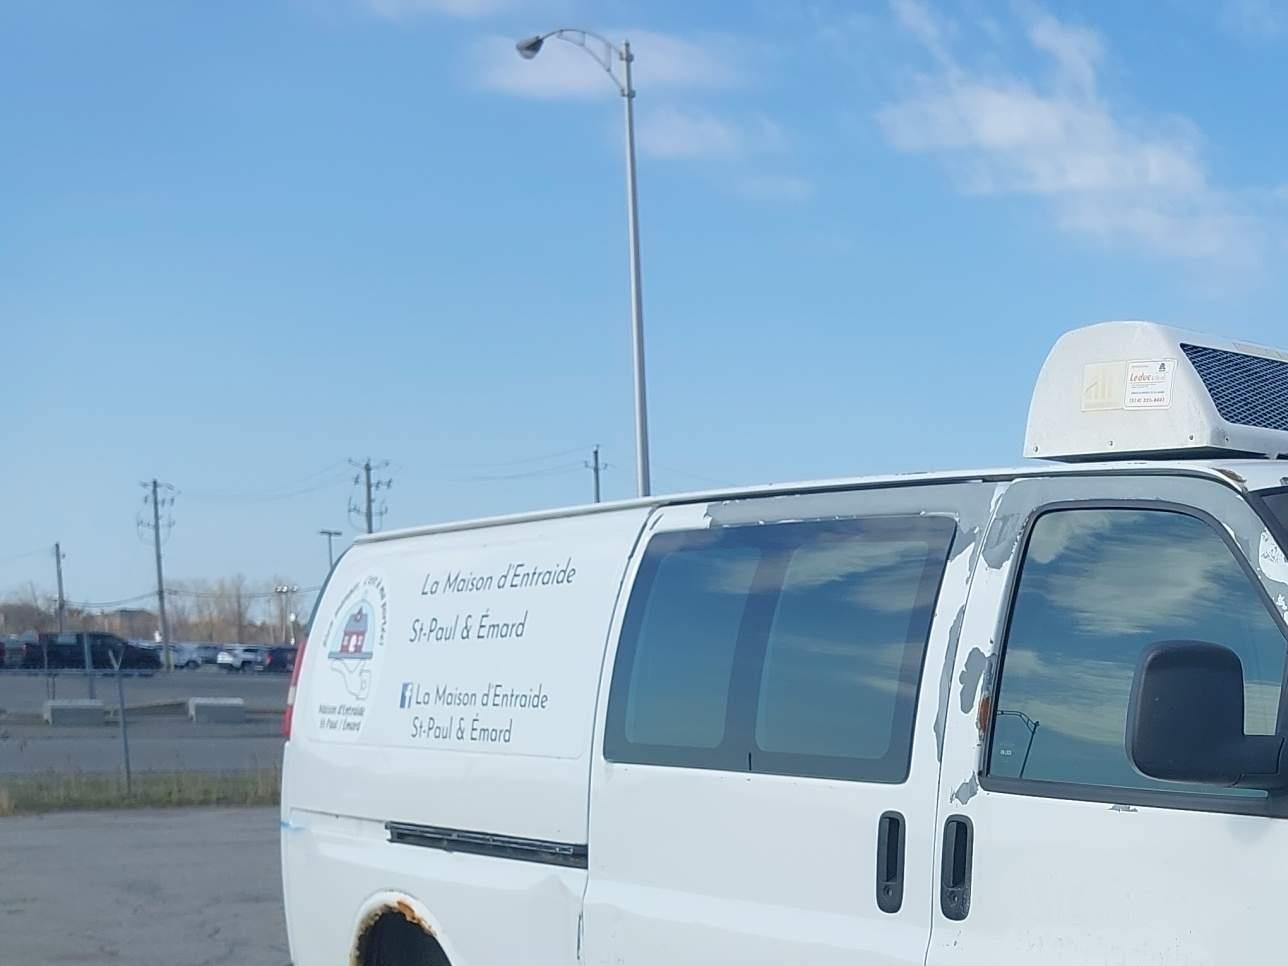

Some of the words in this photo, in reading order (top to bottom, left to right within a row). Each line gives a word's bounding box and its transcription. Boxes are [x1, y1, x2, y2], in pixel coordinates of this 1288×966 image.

[421, 572, 440, 596] La
[442, 570, 493, 595] Maison
[497, 556, 577, 590] d'Entraide
[409, 614, 459, 643] St-Paul
[461, 613, 472, 640] &
[477, 607, 528, 640] Émard
[415, 683, 430, 705] La
[434, 684, 477, 707] Maison
[481, 682, 549, 709] d'Entraide
[411, 715, 453, 740] St-Paul
[456, 716, 466, 741] &
[470, 712, 513, 744] Émard
